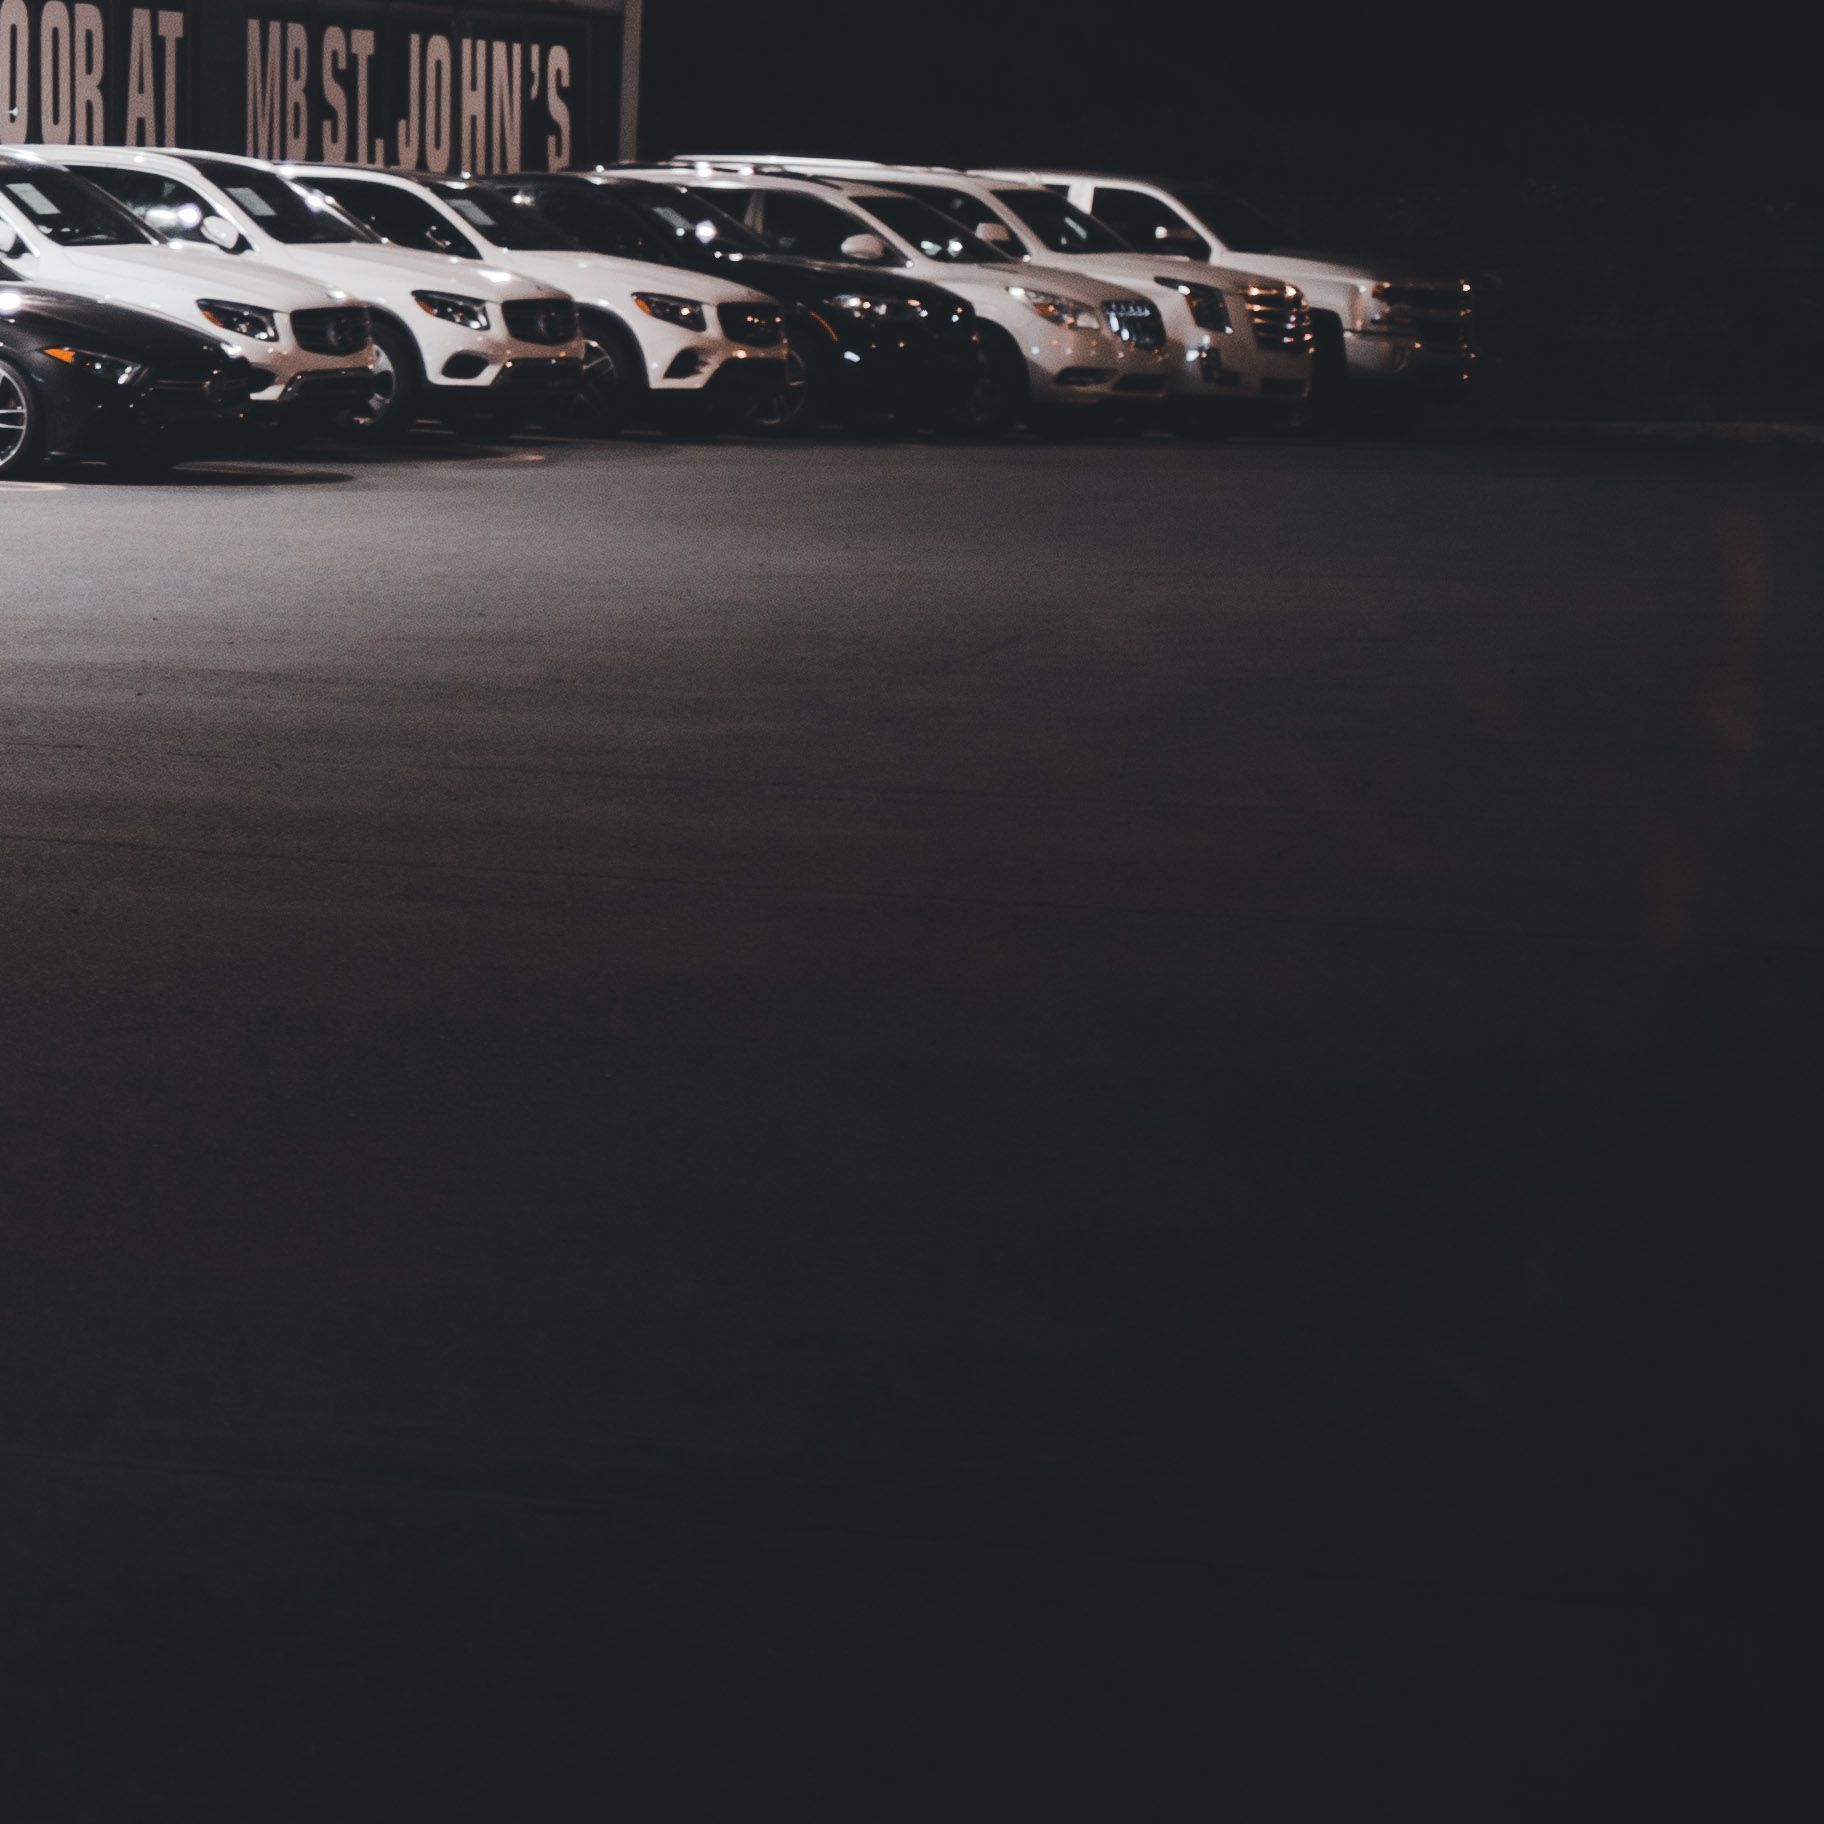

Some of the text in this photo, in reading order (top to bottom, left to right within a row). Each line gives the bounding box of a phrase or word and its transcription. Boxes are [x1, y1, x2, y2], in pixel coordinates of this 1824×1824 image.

[125, 8, 183, 148] AT
[246, 19, 308, 162] MB
[397, 33, 571, 175] JOHN'S
